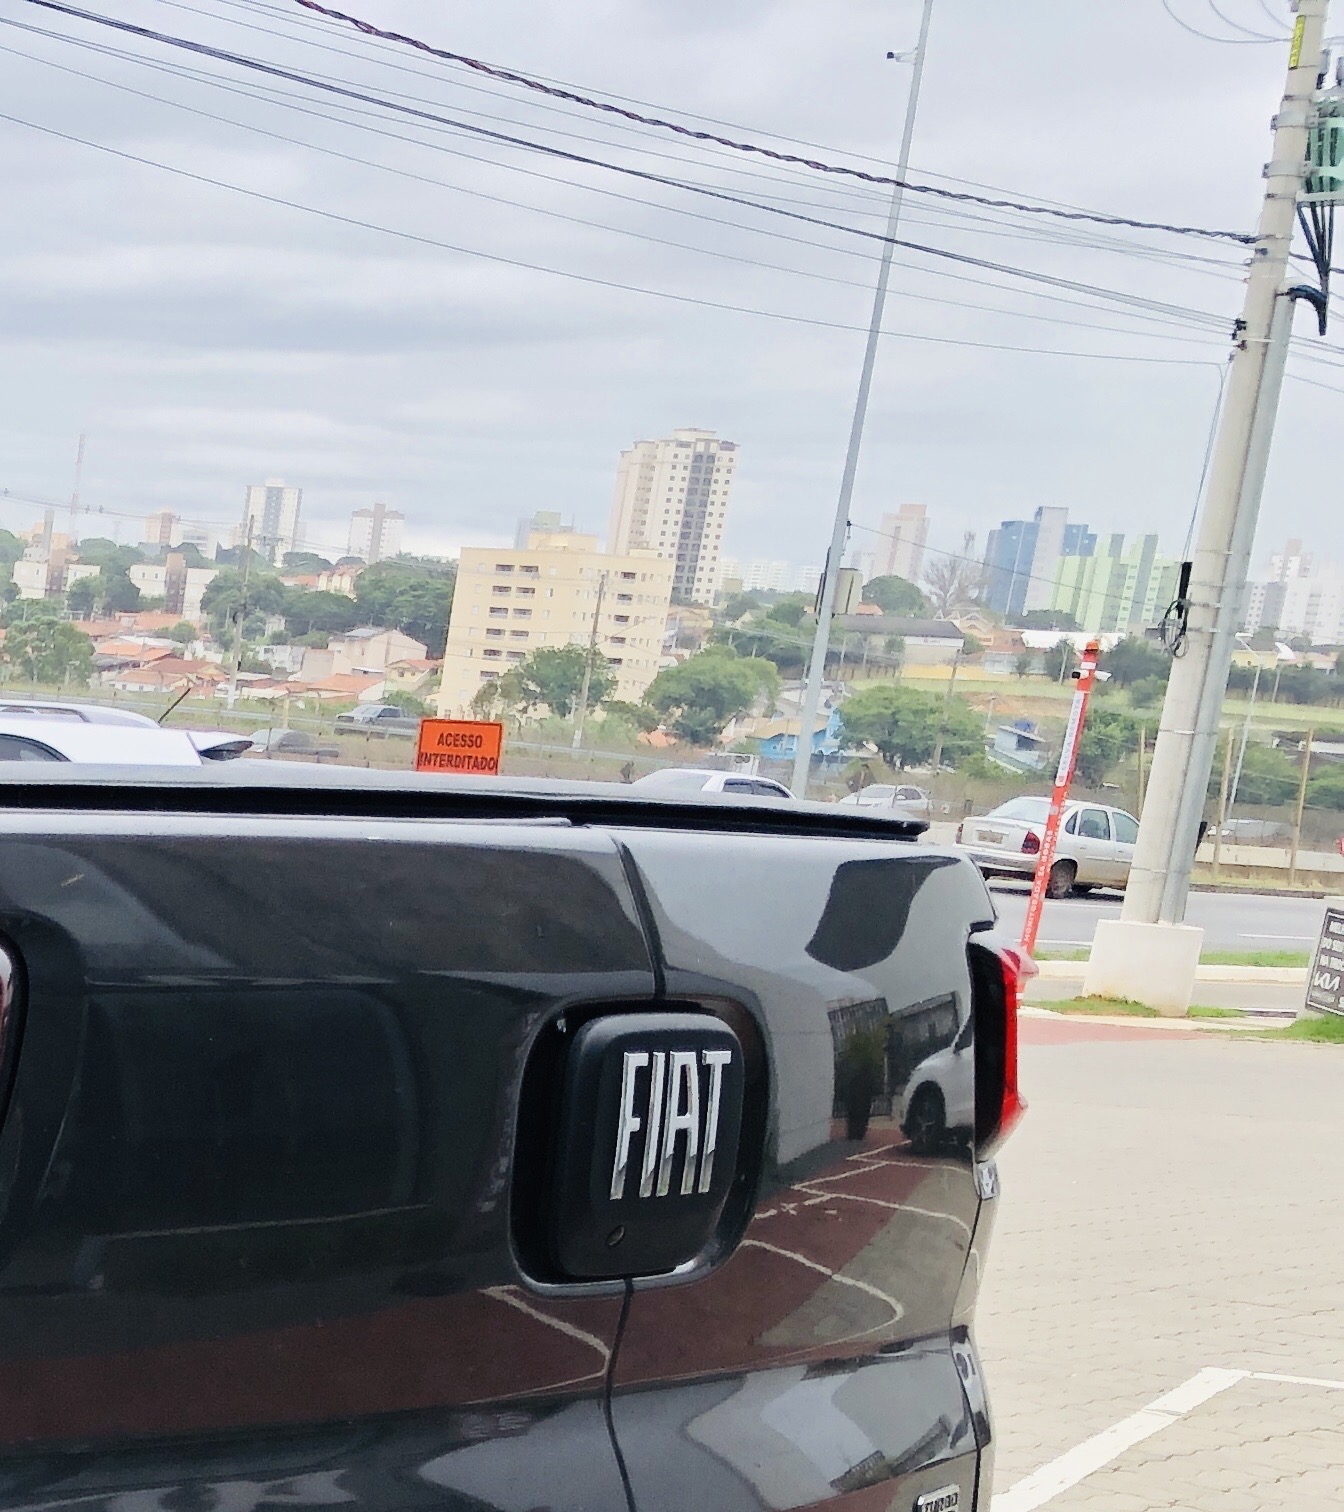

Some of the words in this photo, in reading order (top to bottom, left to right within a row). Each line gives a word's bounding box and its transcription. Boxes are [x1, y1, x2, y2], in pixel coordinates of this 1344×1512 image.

[437, 732, 483, 748] ACESSO
[419, 752, 496, 771] INTERDITADO
[1041, 830, 1054, 862] HORAS
[610, 1050, 732, 1200] FIAT
